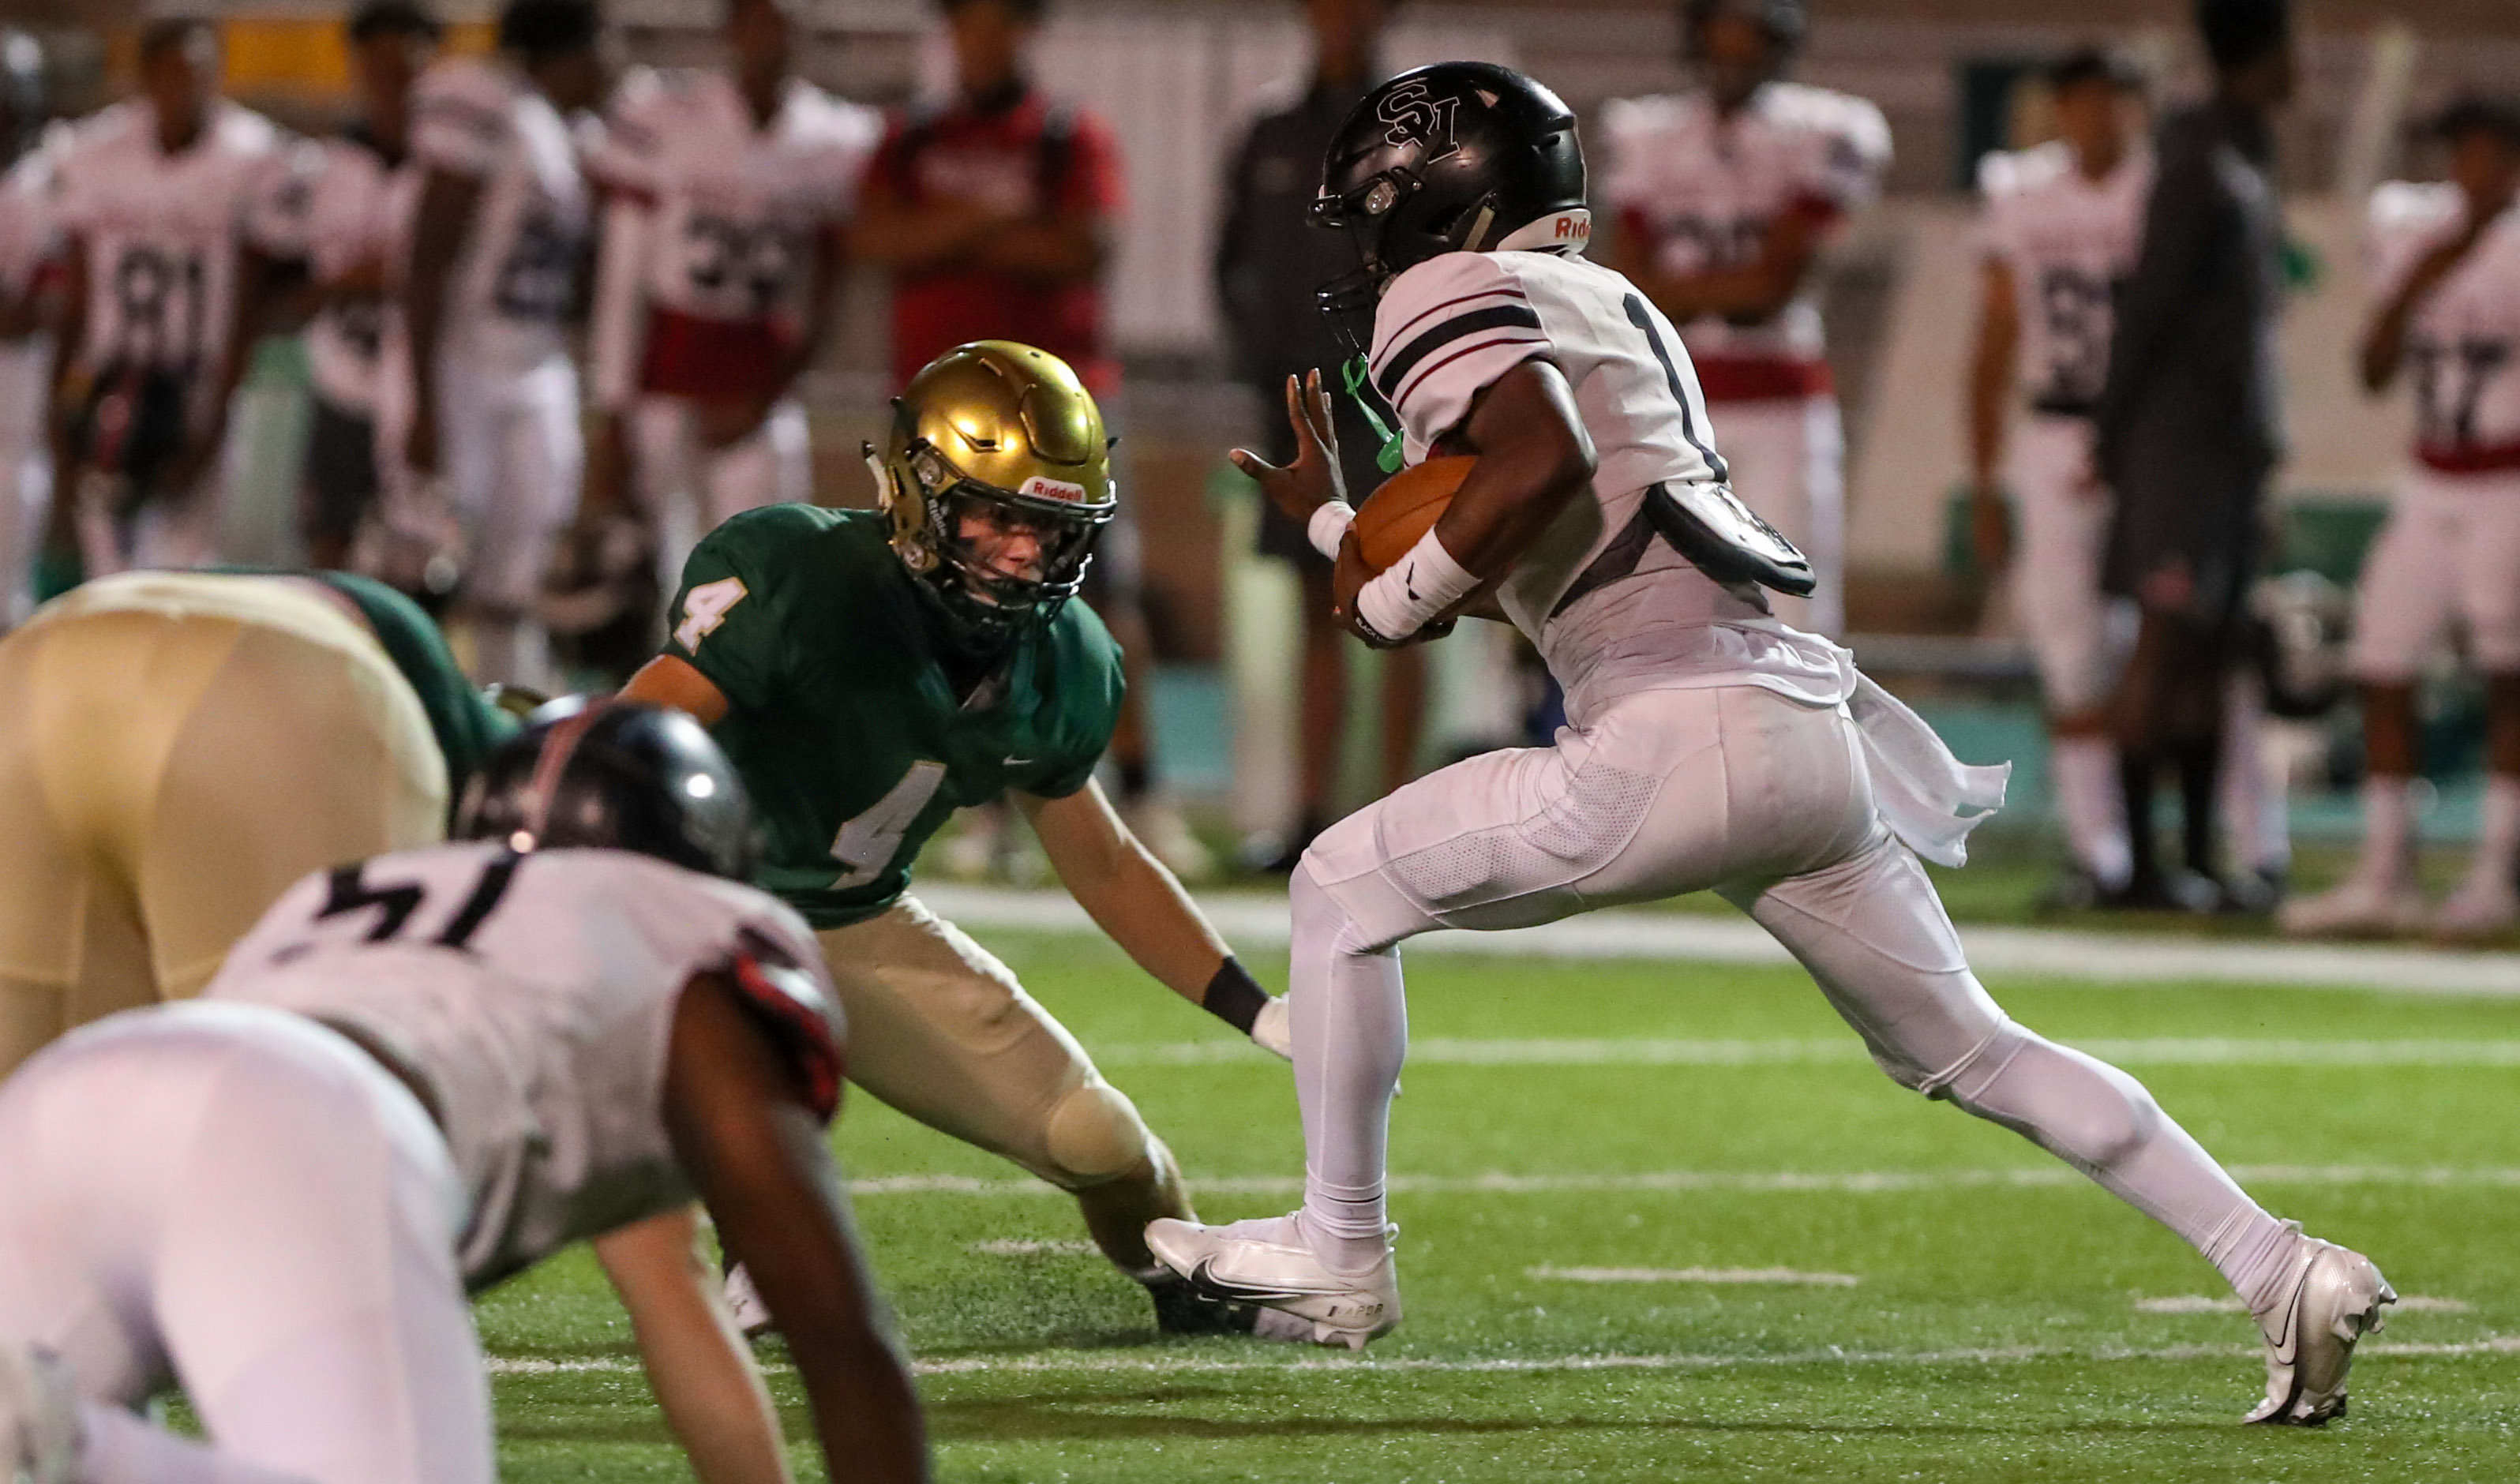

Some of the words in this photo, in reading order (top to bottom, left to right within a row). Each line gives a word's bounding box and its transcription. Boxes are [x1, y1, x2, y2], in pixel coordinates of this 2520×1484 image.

[1622, 293, 1728, 483] 1
[1033, 481, 1083, 502] Riddell
[673, 576, 748, 656] 4
[830, 759, 948, 890] 4
